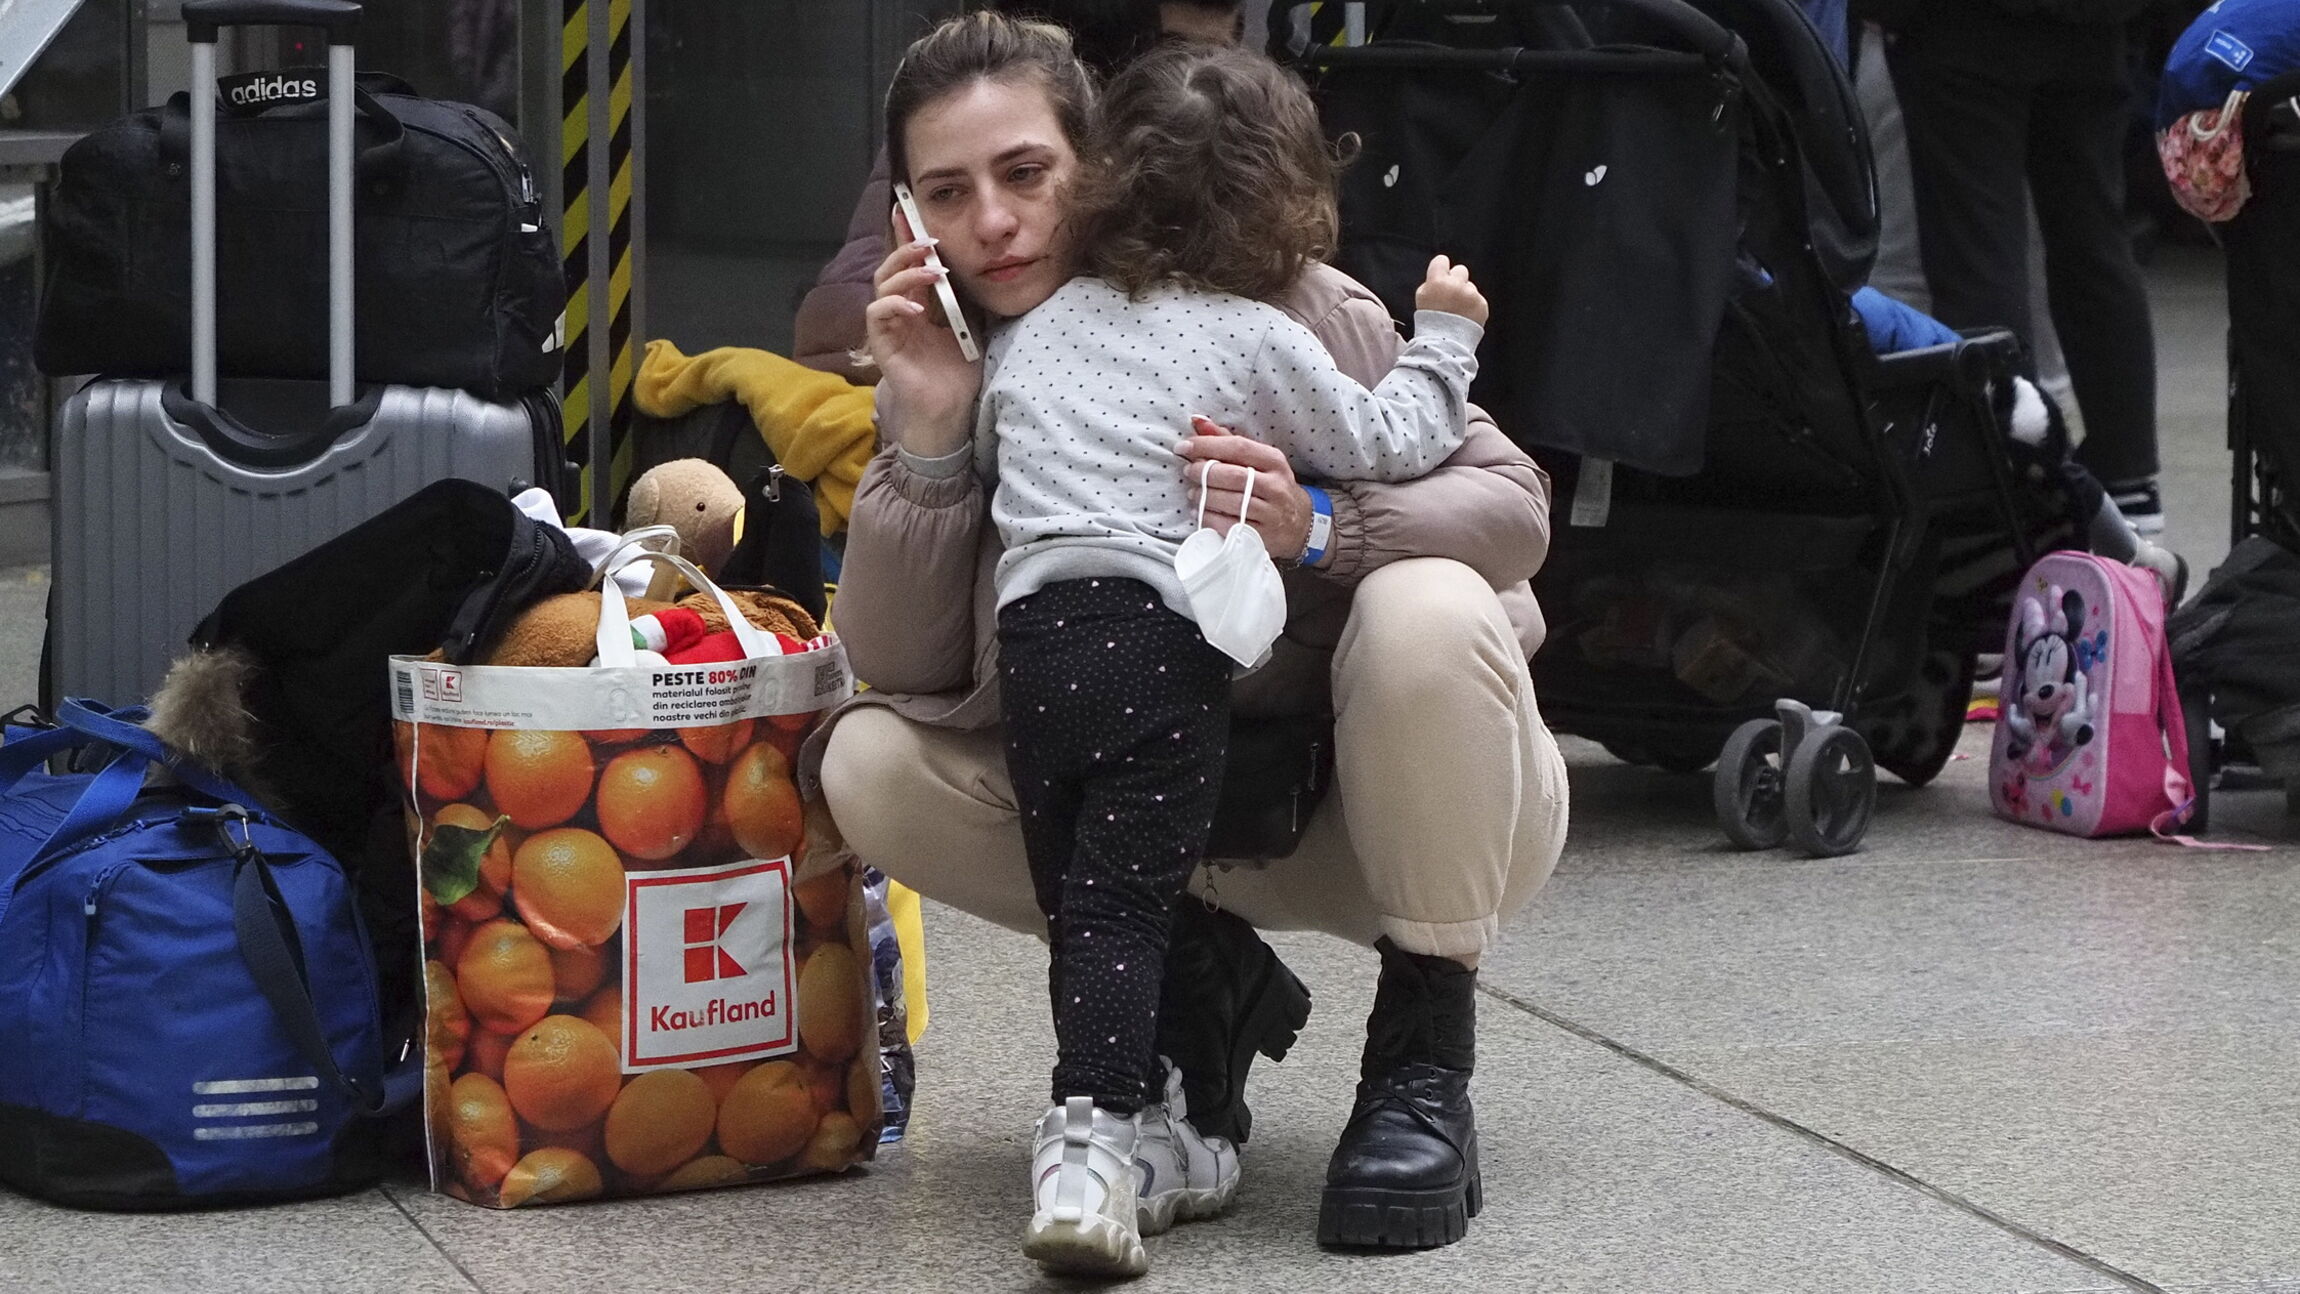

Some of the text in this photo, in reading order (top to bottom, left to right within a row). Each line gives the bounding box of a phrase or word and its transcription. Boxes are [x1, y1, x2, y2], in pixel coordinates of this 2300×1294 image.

[231, 76, 317, 105] adidas
[652, 665, 757, 687] PESTE 80% DIN
[652, 688, 703, 699] materialul
[705, 687, 731, 696] folosit
[652, 702, 669, 711] din
[671, 700, 718, 710] reciclarea
[652, 713, 691, 722] noastre
[694, 711, 718, 720] vechi
[684, 902, 749, 984] K
[651, 990, 775, 1032] Kaufland
